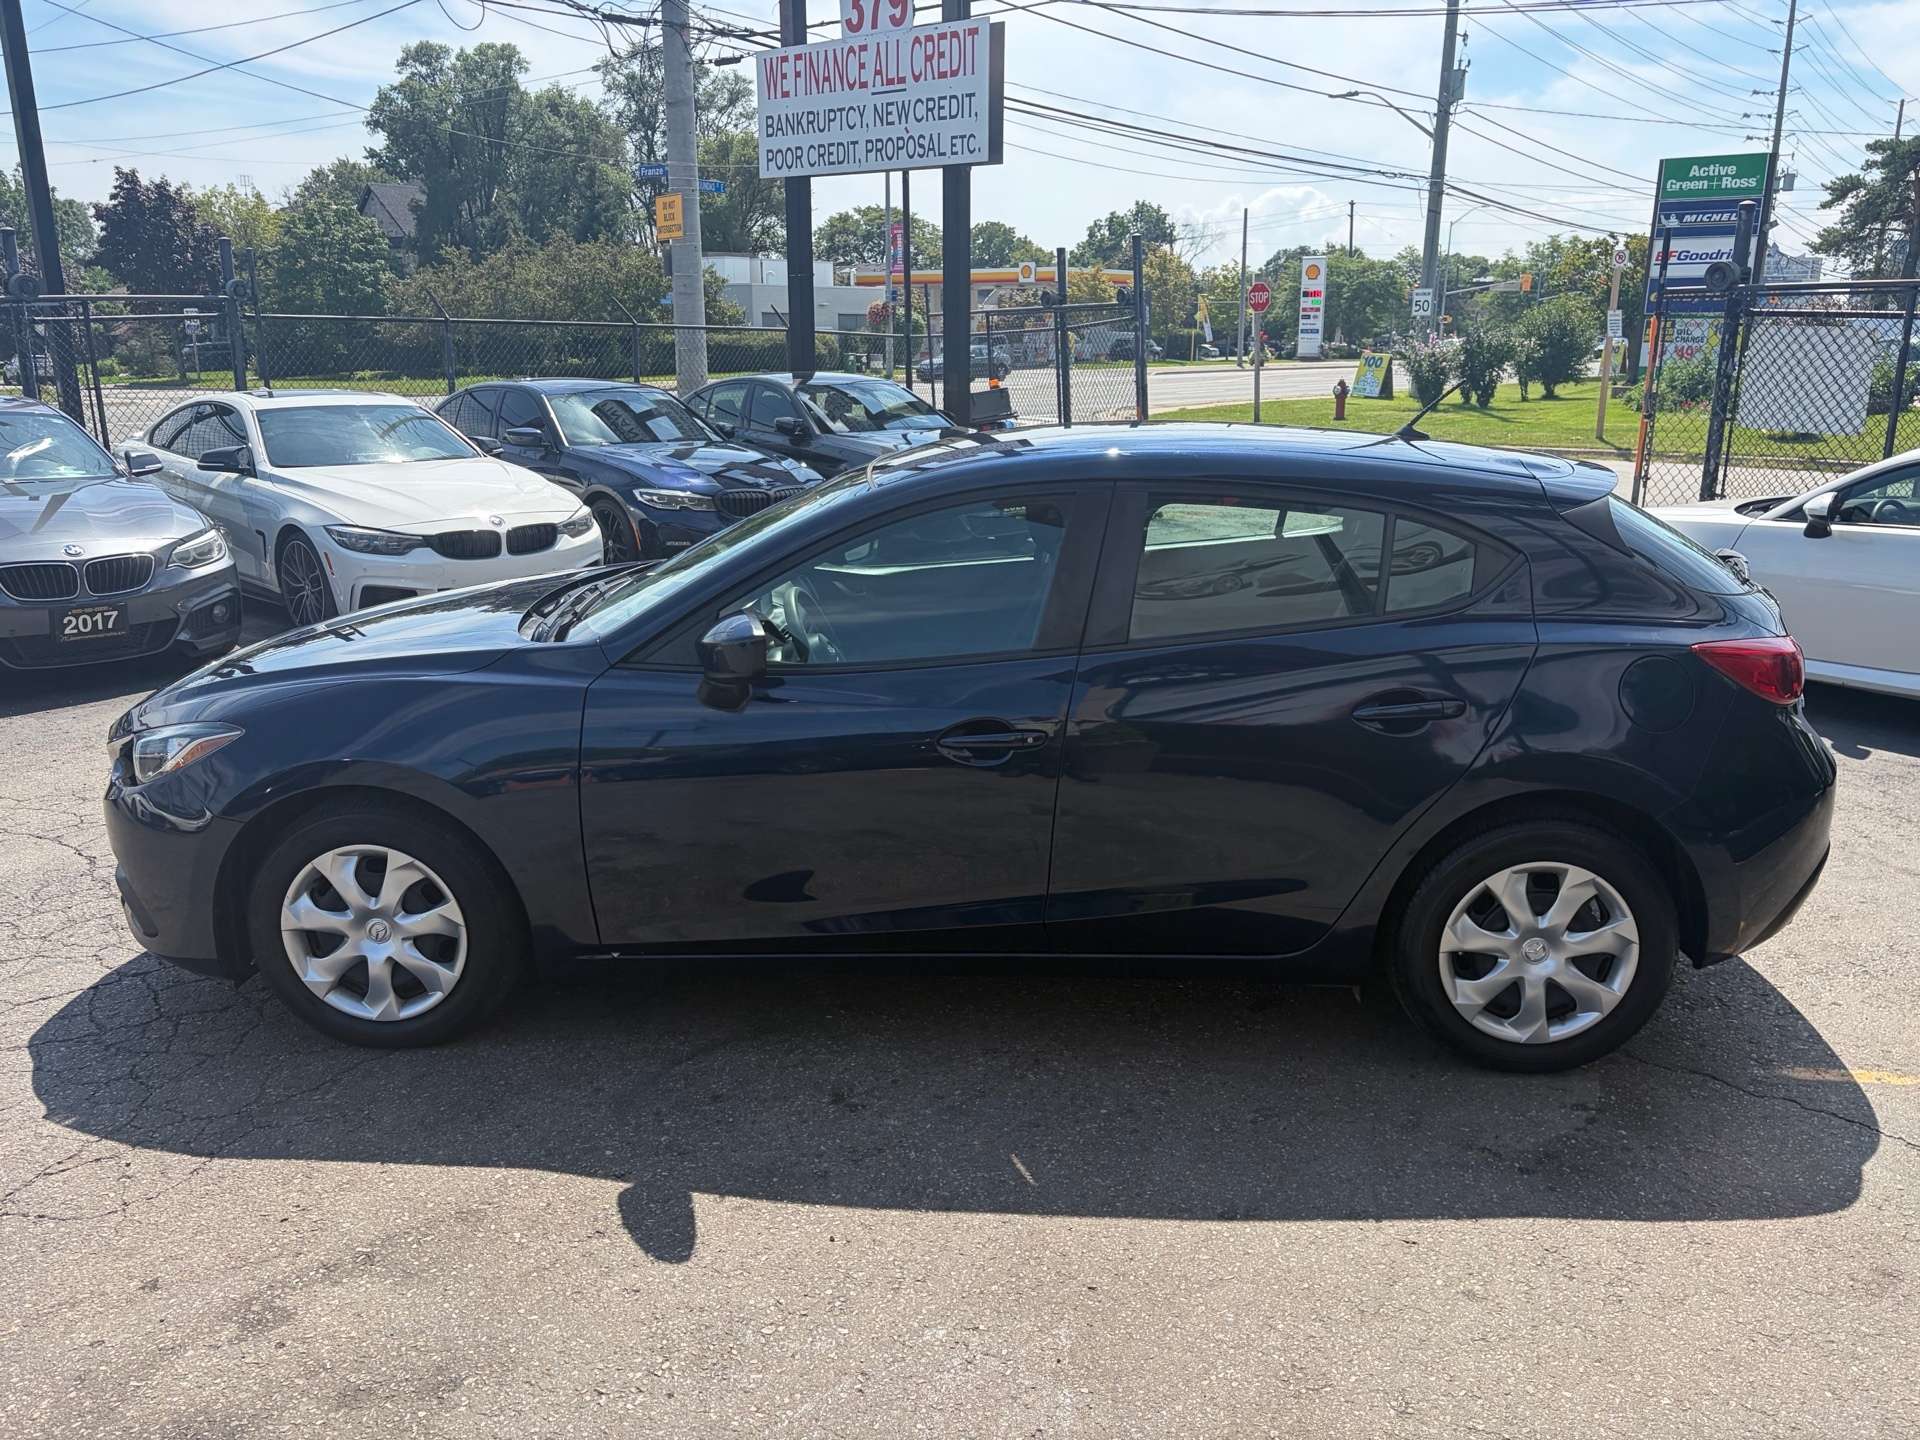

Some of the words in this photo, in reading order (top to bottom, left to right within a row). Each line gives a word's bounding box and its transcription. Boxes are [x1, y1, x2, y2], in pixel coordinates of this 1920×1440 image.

[763, 55, 790, 100] WE
[793, 44, 868, 97] FINANCE
[872, 39, 907, 88] ALL
[910, 27, 979, 83] CREDIT
[765, 104, 869, 138] BANKRUPTCY,
[873, 100, 911, 128] NEW
[912, 92, 978, 124] CREDIT,
[766, 146, 804, 172] POOR
[807, 140, 862, 168] CREDIT,
[950, 133, 981, 156] ETC.
[1689, 164, 1737, 177] Active
[1682, 213, 1738, 223] MICHEL
[1655, 249, 1733, 262] BFGoodri
[1250, 292, 1268, 304] STOP
[1414, 299, 1430, 312] 50
[63, 610, 118, 634] 2017
